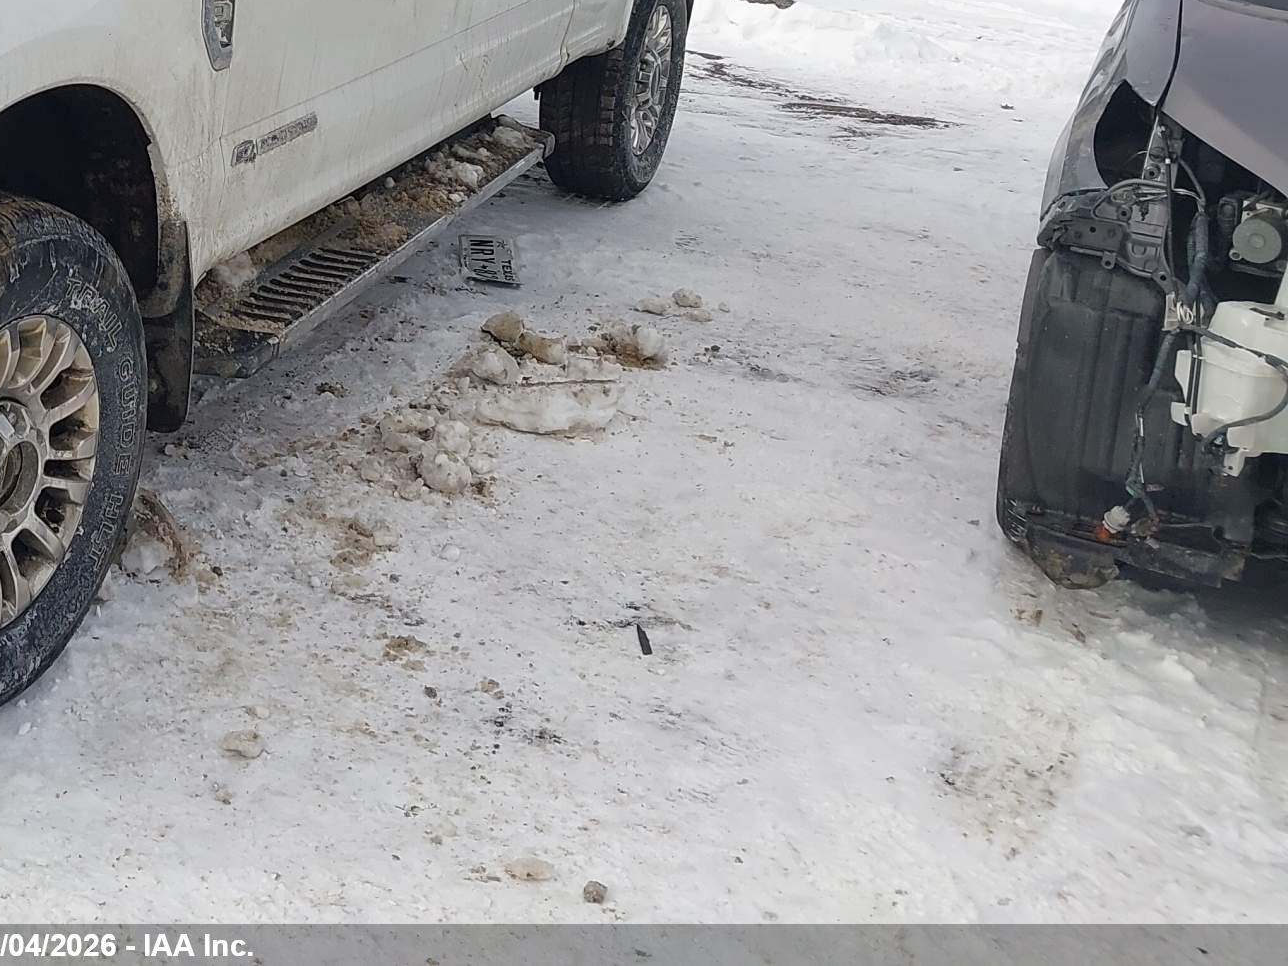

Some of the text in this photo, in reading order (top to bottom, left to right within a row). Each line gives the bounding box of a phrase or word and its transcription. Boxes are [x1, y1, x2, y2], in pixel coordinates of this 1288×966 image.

[65, 277, 137, 572] TRAIL GUIDE HLT
